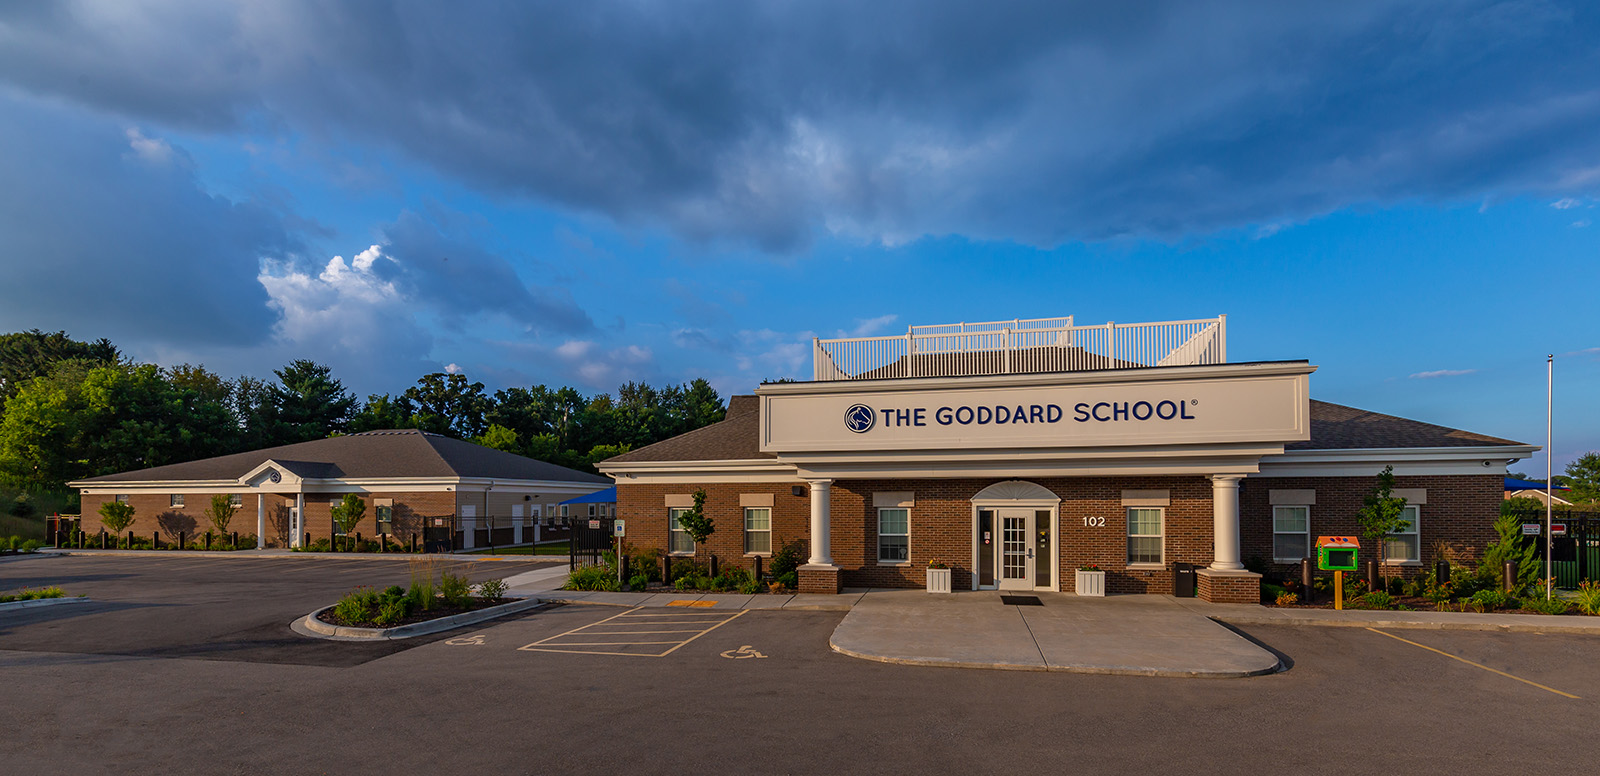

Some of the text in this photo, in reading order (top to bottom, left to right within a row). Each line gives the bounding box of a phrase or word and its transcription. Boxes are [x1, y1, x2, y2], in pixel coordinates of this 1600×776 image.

[880, 408, 927, 427] THE
[935, 404, 1063, 426] GODDARD
[1082, 516, 1106, 527] 102
